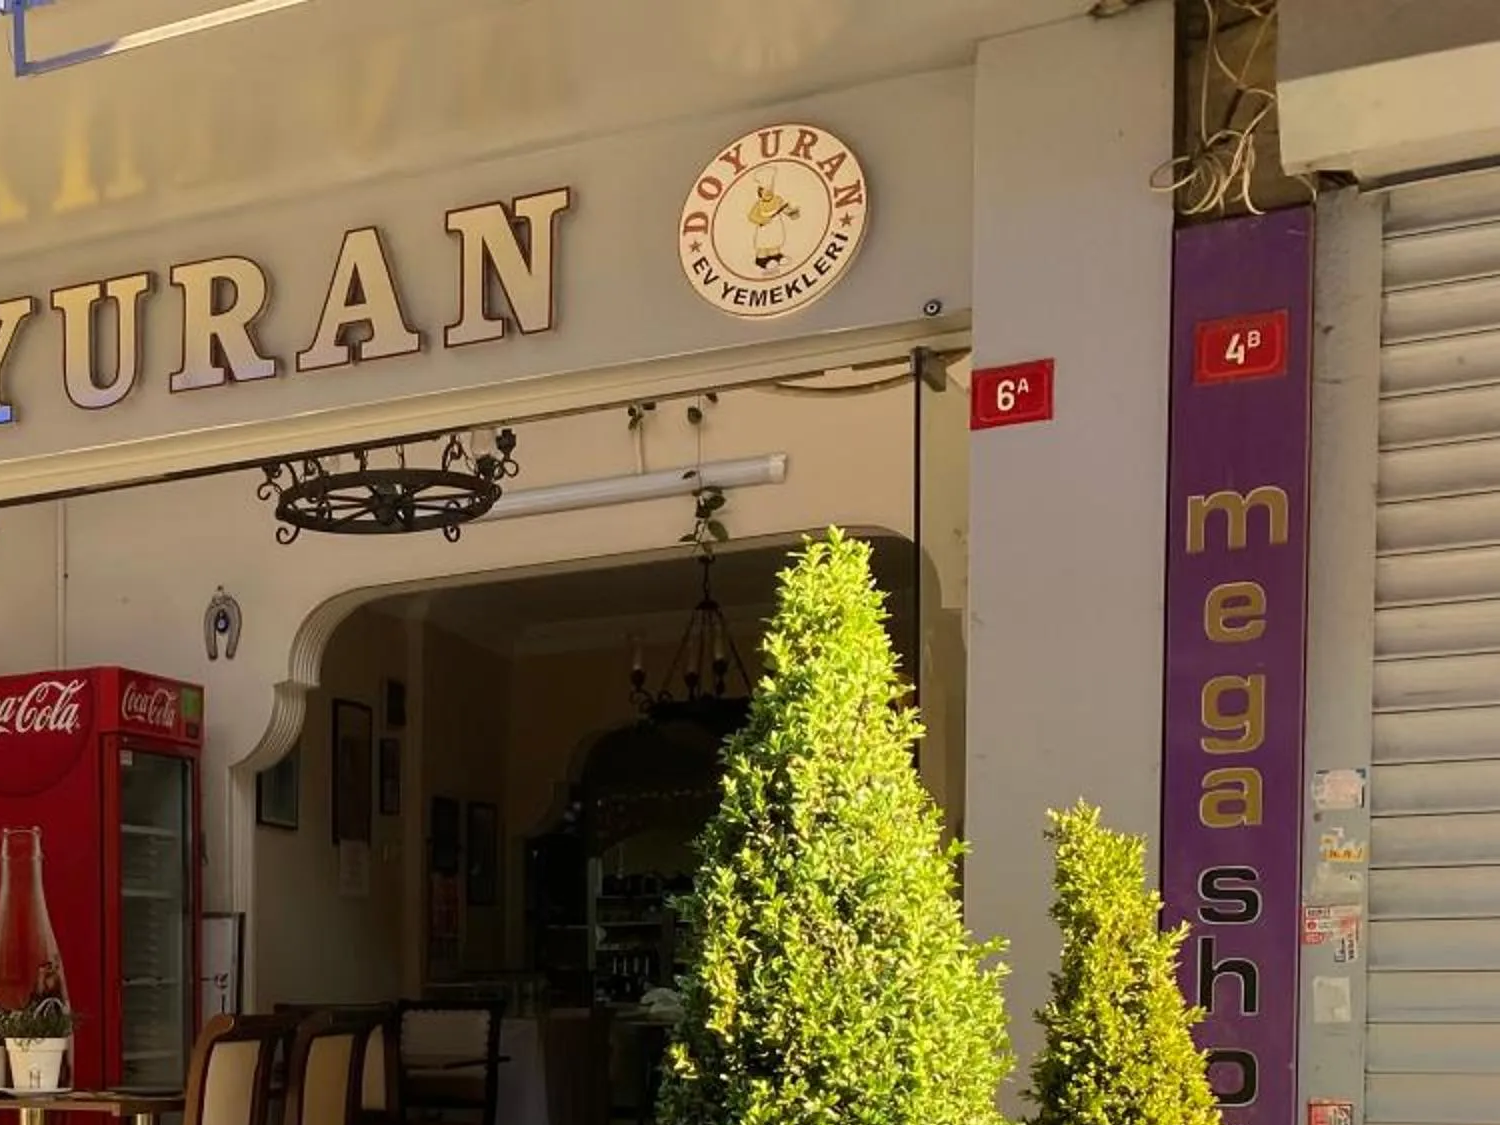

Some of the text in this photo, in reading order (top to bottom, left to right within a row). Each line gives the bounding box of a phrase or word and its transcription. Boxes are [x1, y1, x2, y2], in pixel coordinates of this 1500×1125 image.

[683, 128, 864, 237] DOYURAN
[691, 255, 720, 286] EV
[1185, 485, 1289, 830] mega
[120, 680, 178, 730] Coca-Cola
